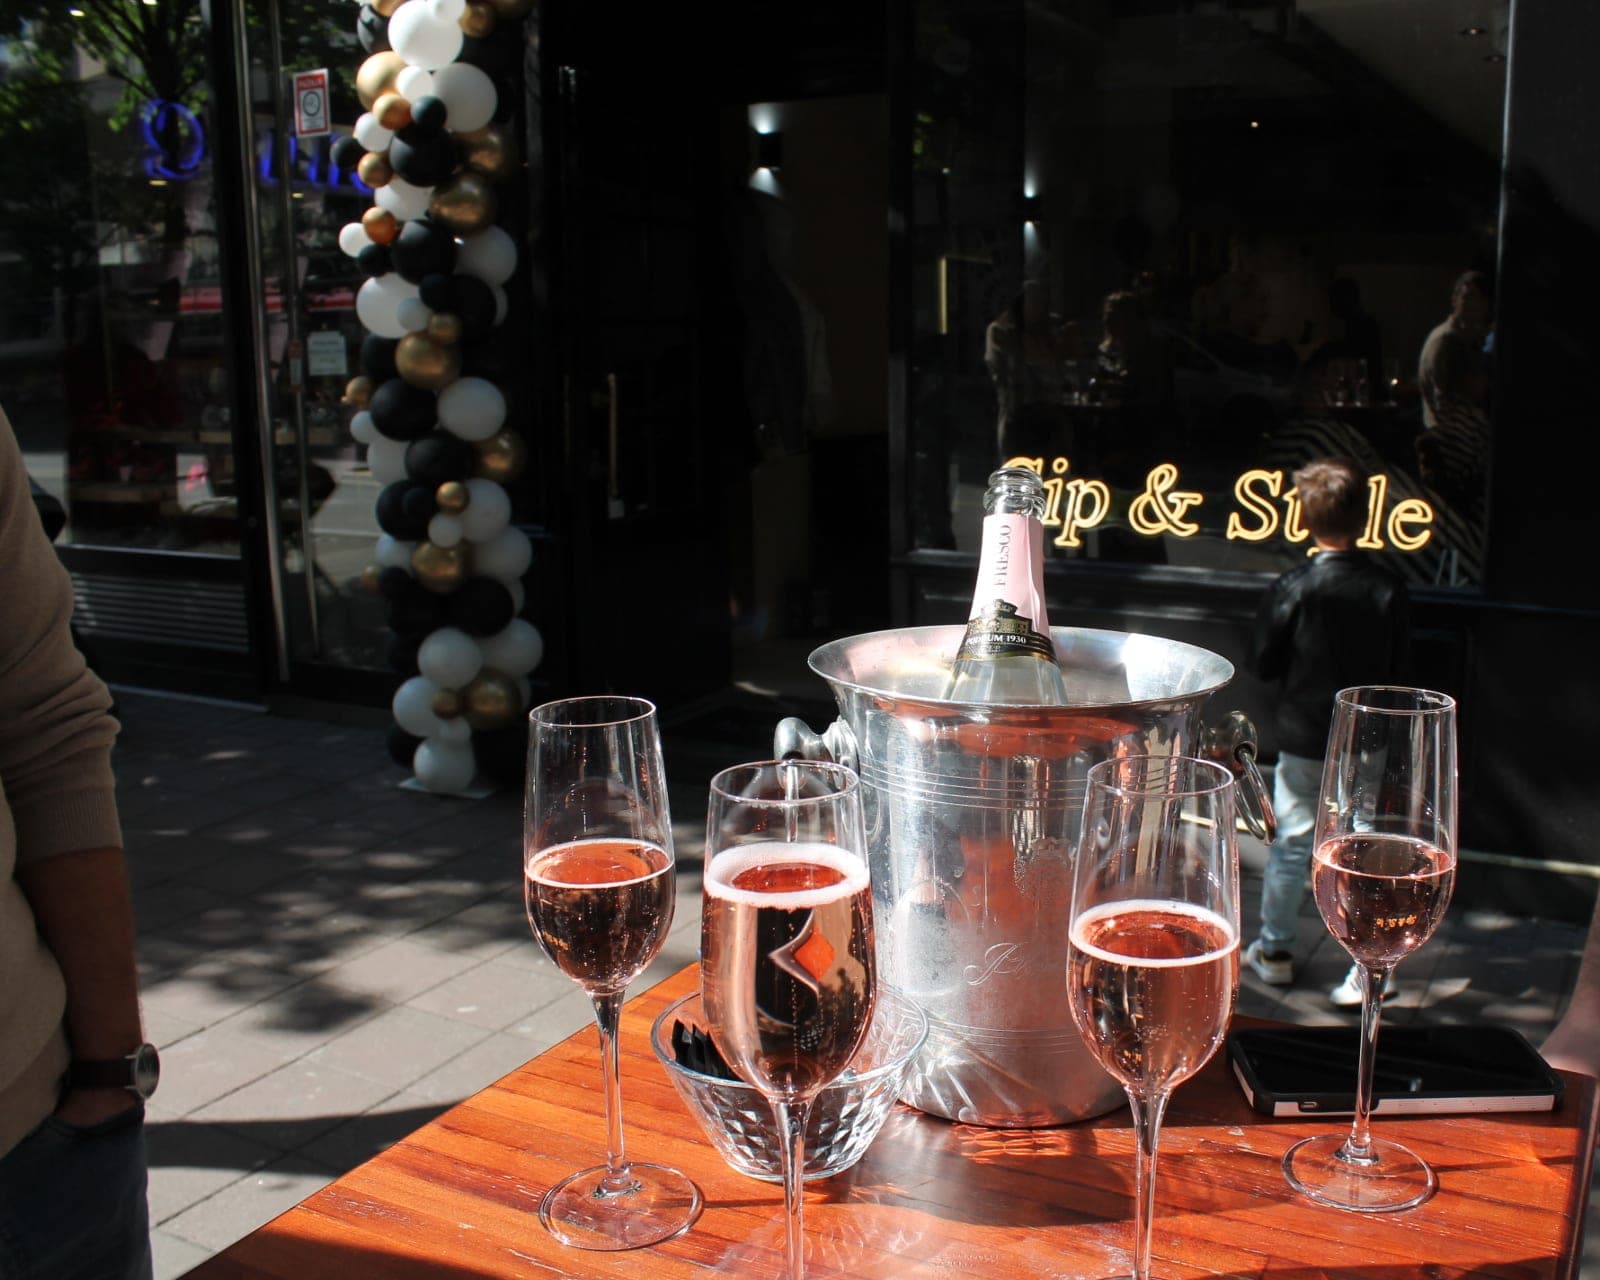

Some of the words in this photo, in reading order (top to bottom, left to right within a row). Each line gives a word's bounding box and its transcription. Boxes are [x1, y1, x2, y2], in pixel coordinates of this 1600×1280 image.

[1128, 463, 1203, 537] &
[1226, 469, 1433, 558] Stle
[993, 524, 1012, 586] FRESCO
[1007, 635, 1027, 645] 1930
